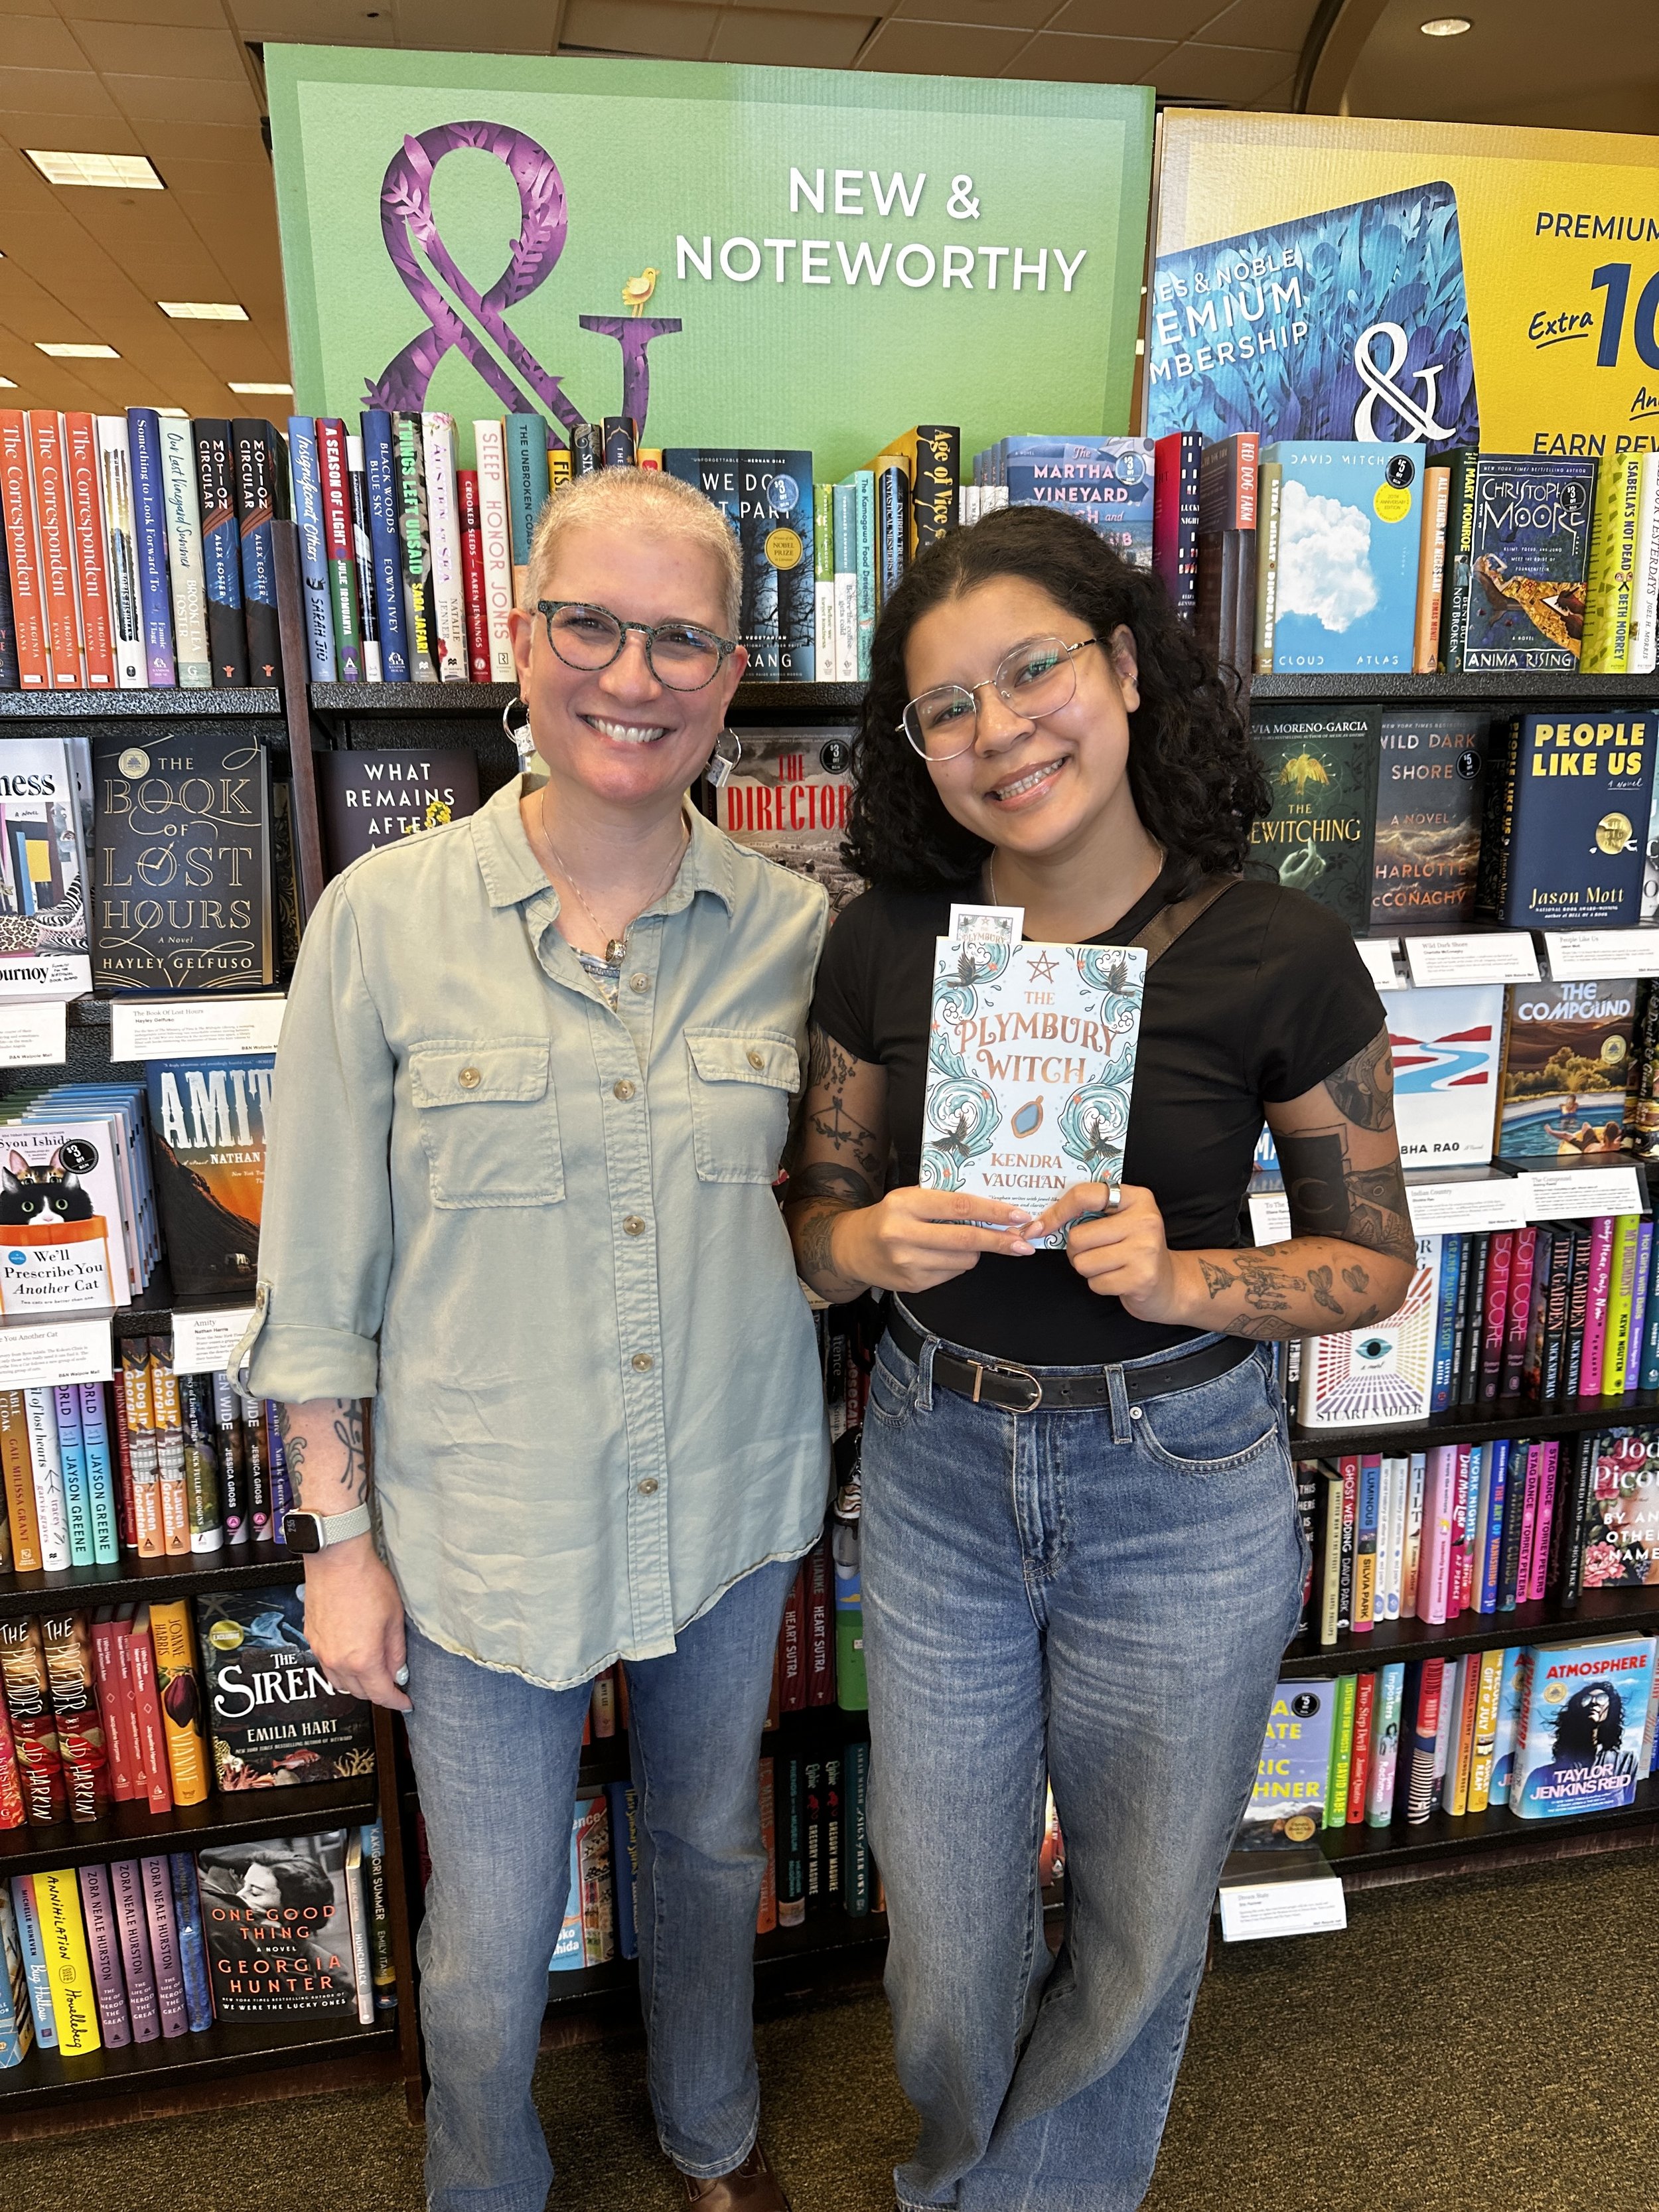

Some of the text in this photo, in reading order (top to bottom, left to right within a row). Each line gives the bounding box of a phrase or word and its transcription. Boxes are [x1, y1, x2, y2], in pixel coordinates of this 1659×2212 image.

[789, 167, 981, 219] NEW &
[676, 234, 1086, 293] NOTEWORTHY
[1194, 249, 1295, 293] & NOBLE
[1529, 311, 1593, 340] Extra
[1150, 321, 1308, 384] MBERSHIP
[1072, 446, 1091, 459] The
[1534, 433, 1605, 455] EARN
[1291, 454, 1333, 465] DAVID
[199, 440, 214, 509] CIRCULAR
[325, 427, 346, 546] A SEASON OF LIGHT
[370, 460, 383, 517] BLUE SKY
[380, 442, 396, 534] BLACK WOODS
[702, 473, 735, 491] WE
[929, 427, 952, 525] Age of Vice
[1240, 441, 1255, 522] RED DOG FARM
[137, 419, 157, 593] Something to Look Forward To
[167, 432, 190, 569] Our Last Vineyard Summer
[295, 434, 319, 563] Insignificant Others
[398, 420, 422, 575] THINGS LEFT UNSAID
[1034, 488, 1128, 502] VINEYARD
[3, 425, 34, 598] The Correspondent
[38, 425, 68, 598] The Correspondent
[1461, 467, 1476, 552] MARY MONROE
[482, 433, 509, 640] SLEEP HONOR JONES
[1624, 526, 1634, 546] NOT
[214, 534, 226, 597] ALEX FOSTER
[1623, 546, 1633, 572] DEAD
[337, 560, 352, 635] JULIE IROMUANYA
[383, 558, 398, 633] EOWYN IVEY
[411, 583, 428, 654] SARA JAFARI
[1613, 593, 1628, 661] BETH MORREY
[1279, 654, 1399, 666] CLOUD ATLAS
[1468, 650, 1572, 668] ANIMA RISING
[1273, 721, 1368, 734] MORENO-GARCIA
[1429, 733, 1475, 749] DARK
[1534, 723, 1646, 747] PEOPLE
[158, 757, 193, 770] THE
[364, 763, 431, 780] WHAT
[779, 754, 805, 782] THE
[1392, 765, 1453, 780] SHORE
[1532, 752, 1642, 776] LIKE US
[104, 778, 253, 814] BOOK
[346, 788, 455, 808] REMAINS
[1289, 804, 1313, 814] THE
[164, 824, 188, 836] OF
[1391, 813, 1449, 825] A NOVEL
[104, 847, 252, 887] LOST
[1529, 886, 1624, 909] Jason Mott
[104, 899, 252, 930] HOURS
[103, 957, 252, 969] HAYLEY GELFUSO
[1025, 991, 1055, 1005] THE
[1560, 982, 1597, 1000] THE
[1518, 998, 1631, 1021] COMPOUND
[954, 1012, 1120, 1057] PLYMBURY
[976, 1049, 1086, 1084] WITCH
[210, 1153, 260, 1165] NATHAN
[990, 1152, 1062, 1169] KENDRA
[1433, 1142, 1460, 1152] RAO
[982, 1173, 1067, 1189] VAUGHAN
[4, 1263, 104, 1280] Prescribe You
[13, 1279, 100, 1295] Another Cat
[1316, 1404, 1423, 1423] STUART NADLER
[224, 1447, 236, 1508] JESSICA GROSS
[1543, 1448, 1557, 1506] STAG DANCE
[66, 1455, 86, 1552] JAYSON GREENE
[1366, 1471, 1374, 1526] LUMINOUS
[1604, 1512, 1625, 1524] BY
[1535, 1520, 1550, 1593] TORREY PETERS
[1360, 1589, 1370, 1619] PARK
[155, 1623, 170, 1657] HARRIS
[169, 1619, 186, 1658] JOANNE
[814, 1606, 825, 1672] HEART SUTRA
[271, 1653, 297, 1667] THE
[1546, 1655, 1647, 1680] ATMOSPHERE
[247, 1720, 338, 1743] EMILIA HART
[170, 1731, 199, 1785] VIANNE
[1530, 1775, 1630, 1800] JENKINS REID
[1553, 1764, 1613, 1783] TAYLOR
[809, 1824, 818, 1895] GREGORY MAGUIRE
[88, 1872, 111, 1980] ZORA NEALE HURSTON
[212, 1905, 336, 1921] ONE GOOD
[240, 1926, 310, 1940] THING
[218, 1956, 342, 1974] GEORGIA
[354, 1933, 368, 1986] HUNCHBACK
[230, 1975, 334, 1993] HUNTER
